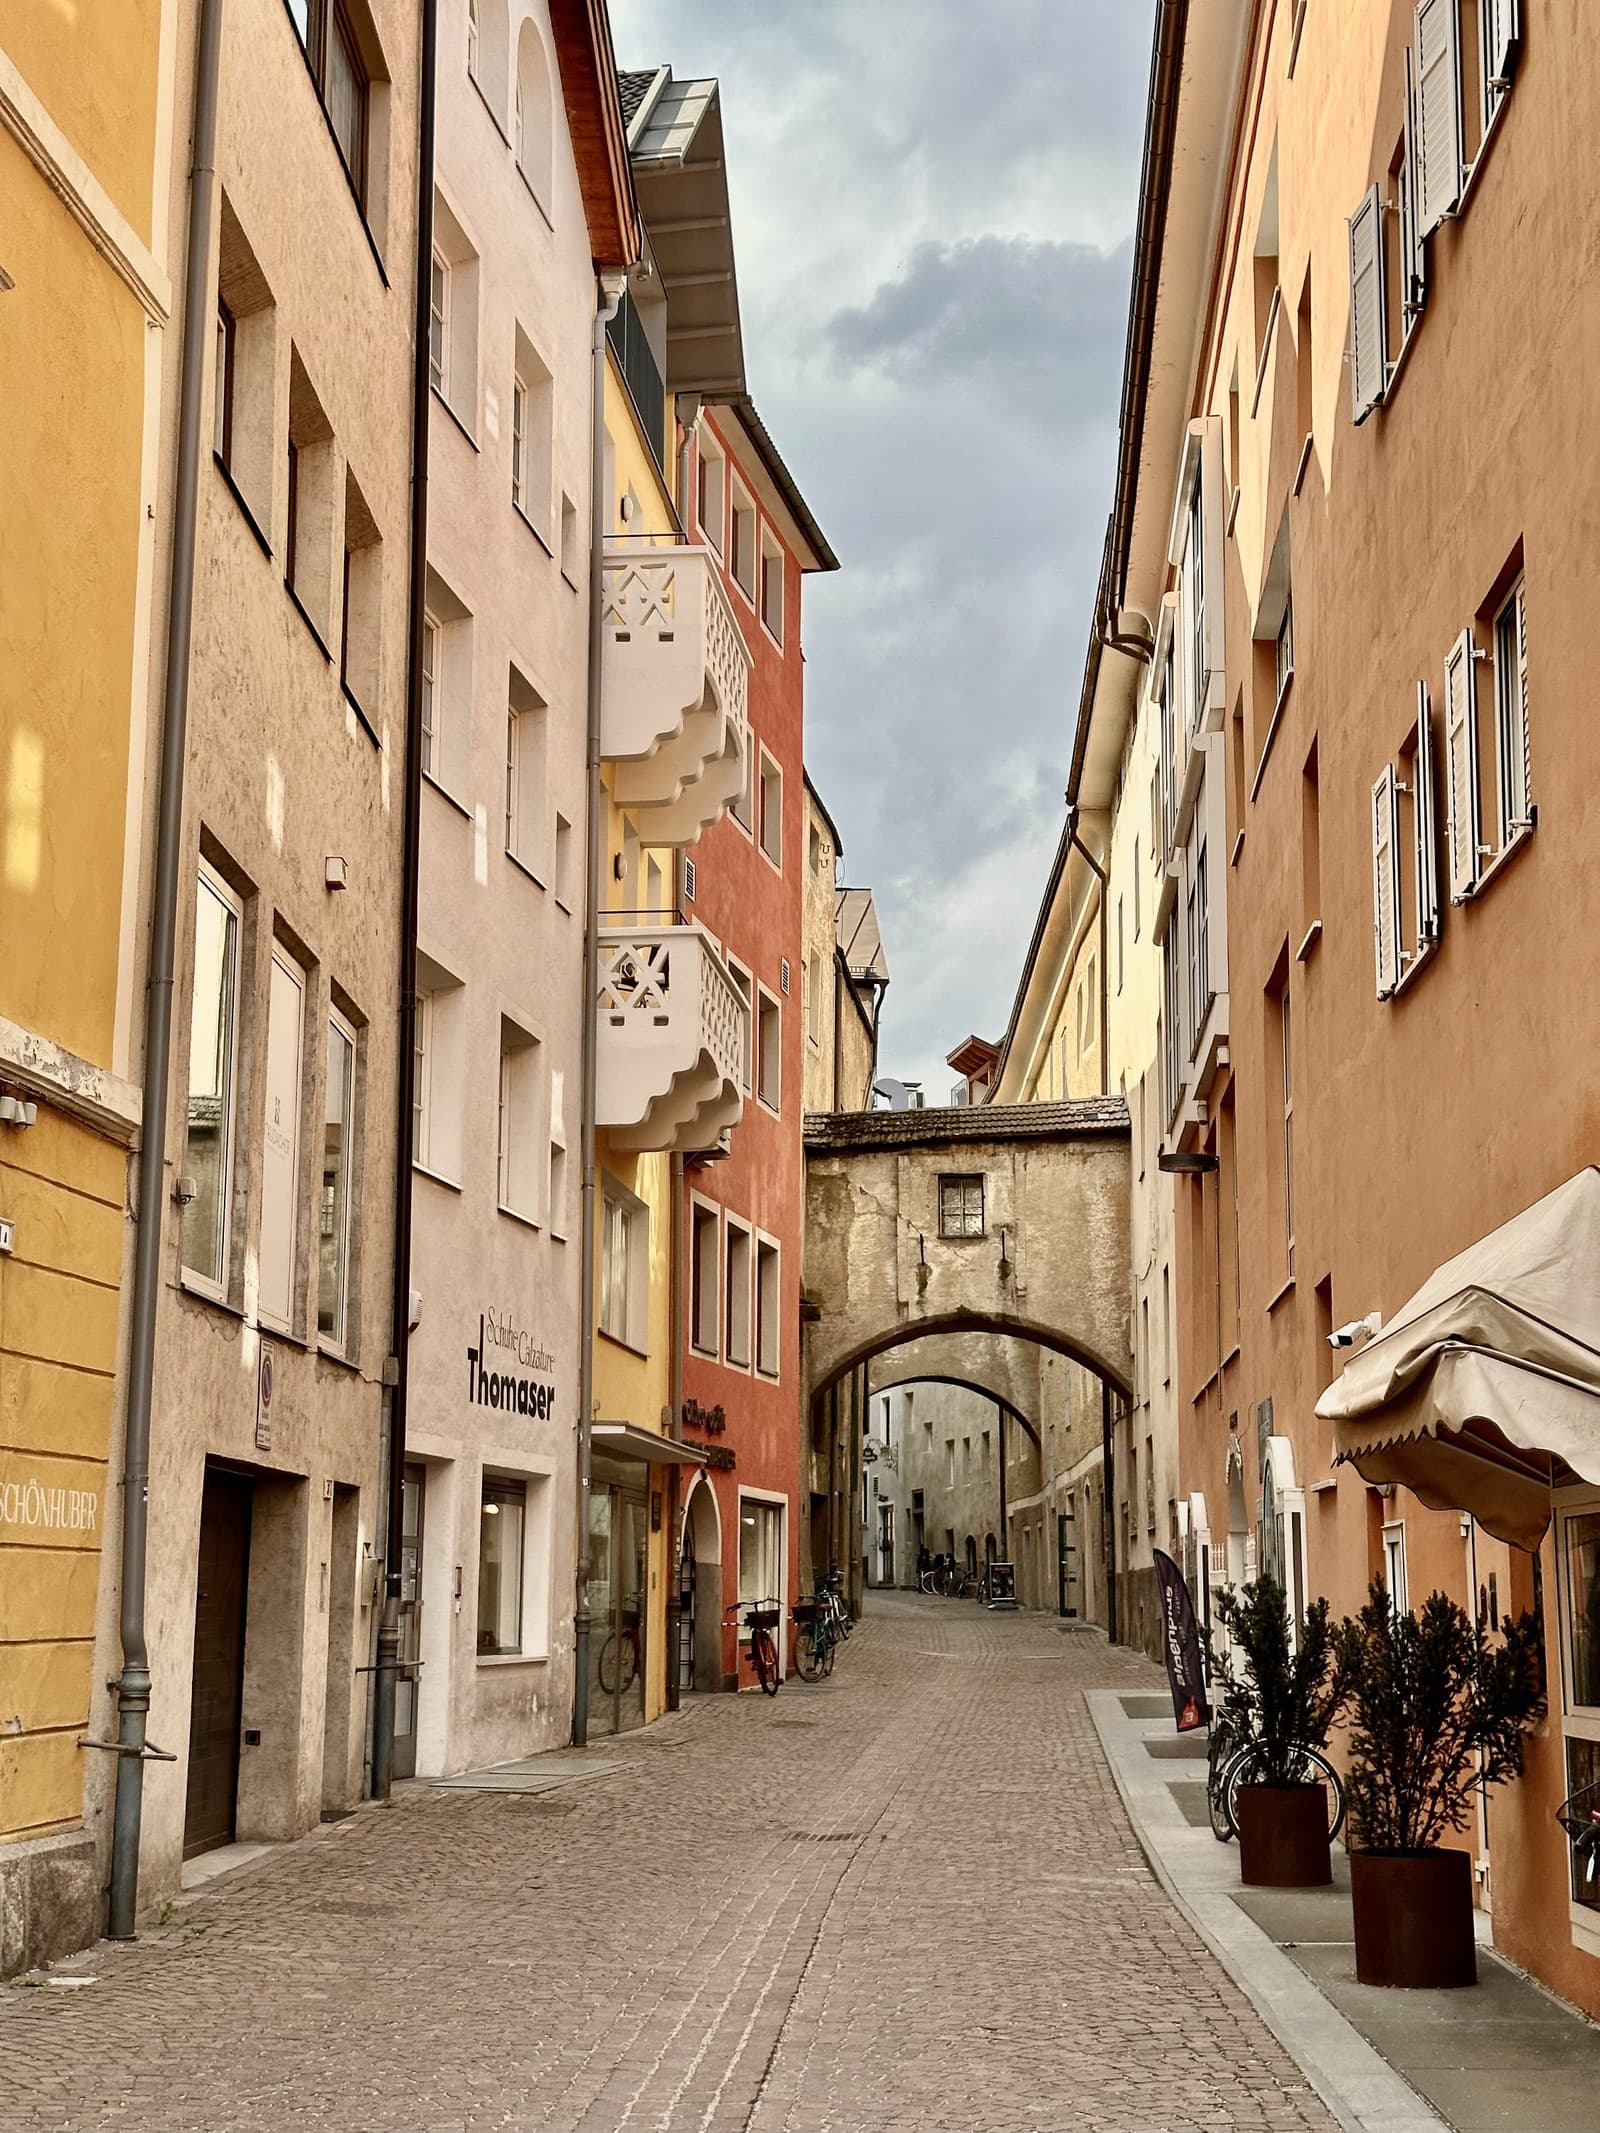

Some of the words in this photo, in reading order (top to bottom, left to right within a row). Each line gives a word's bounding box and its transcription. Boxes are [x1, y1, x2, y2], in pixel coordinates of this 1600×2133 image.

[467, 1313, 555, 1421] Thomaser
[486, 1305, 519, 1352] Schuhe
[518, 1330, 556, 1374] Calzature
